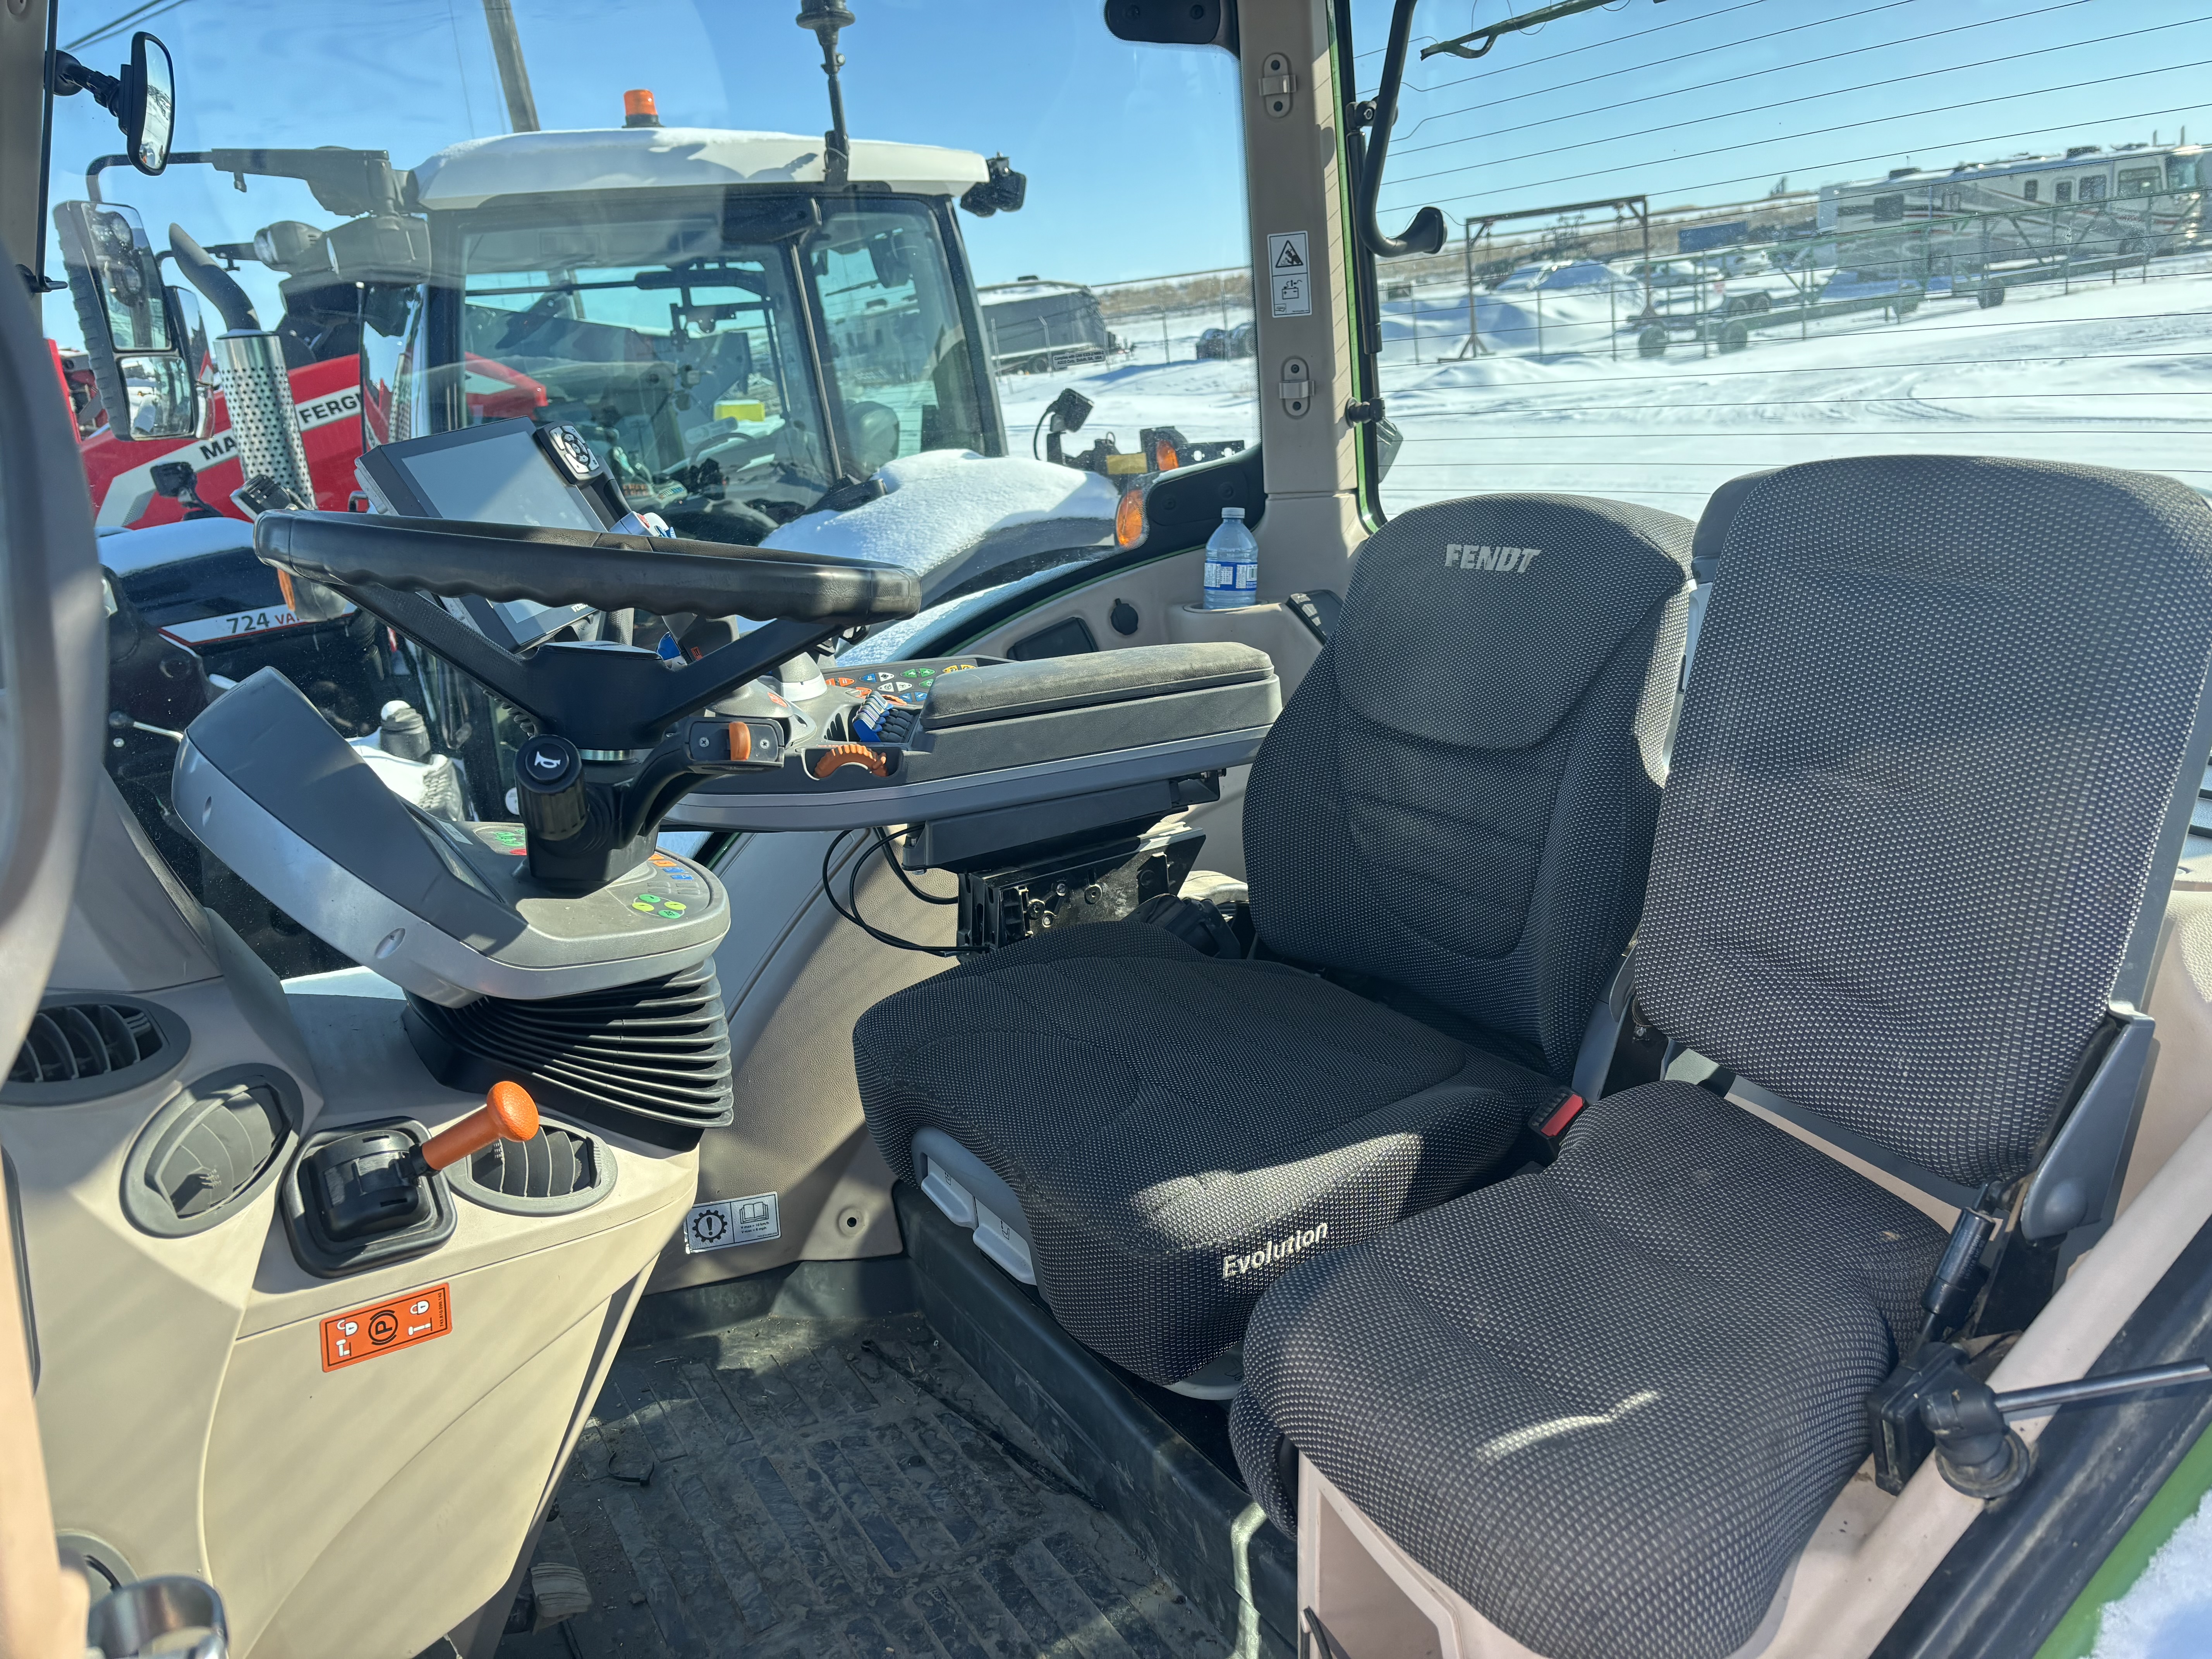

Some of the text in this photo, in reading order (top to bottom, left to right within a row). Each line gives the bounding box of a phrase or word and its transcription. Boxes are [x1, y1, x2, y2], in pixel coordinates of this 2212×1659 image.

[1444, 544, 1542, 573] FENDT
[226, 613, 300, 634] 724 VA
[1222, 1223, 1328, 1279] Evolution
